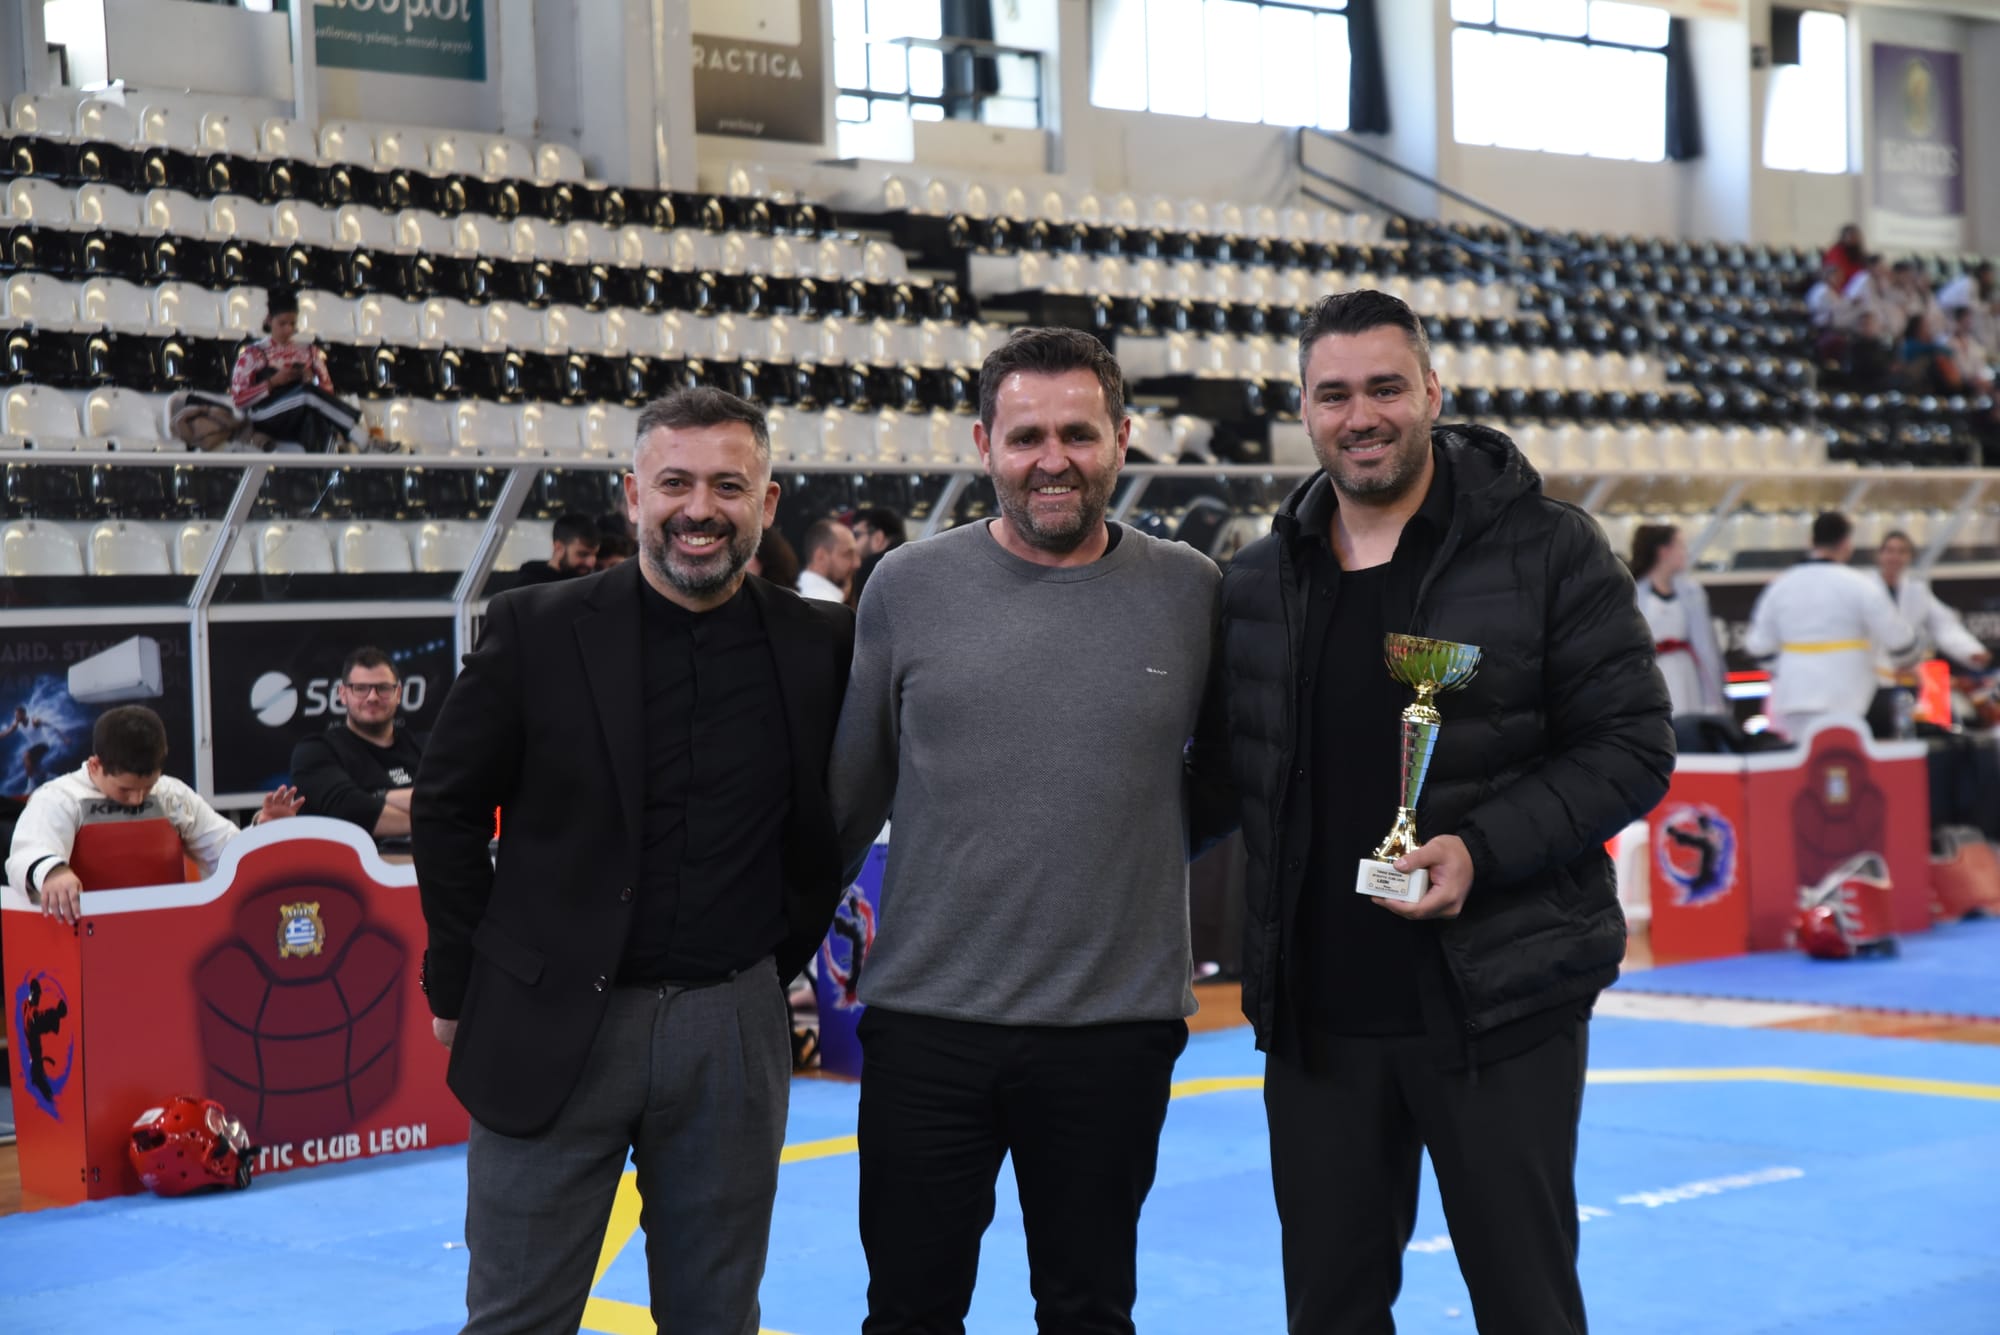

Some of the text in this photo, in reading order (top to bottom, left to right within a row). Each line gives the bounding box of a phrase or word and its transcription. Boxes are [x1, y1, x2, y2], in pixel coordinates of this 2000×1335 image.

[251, 1122, 427, 1172] TIC CLUB LEON
